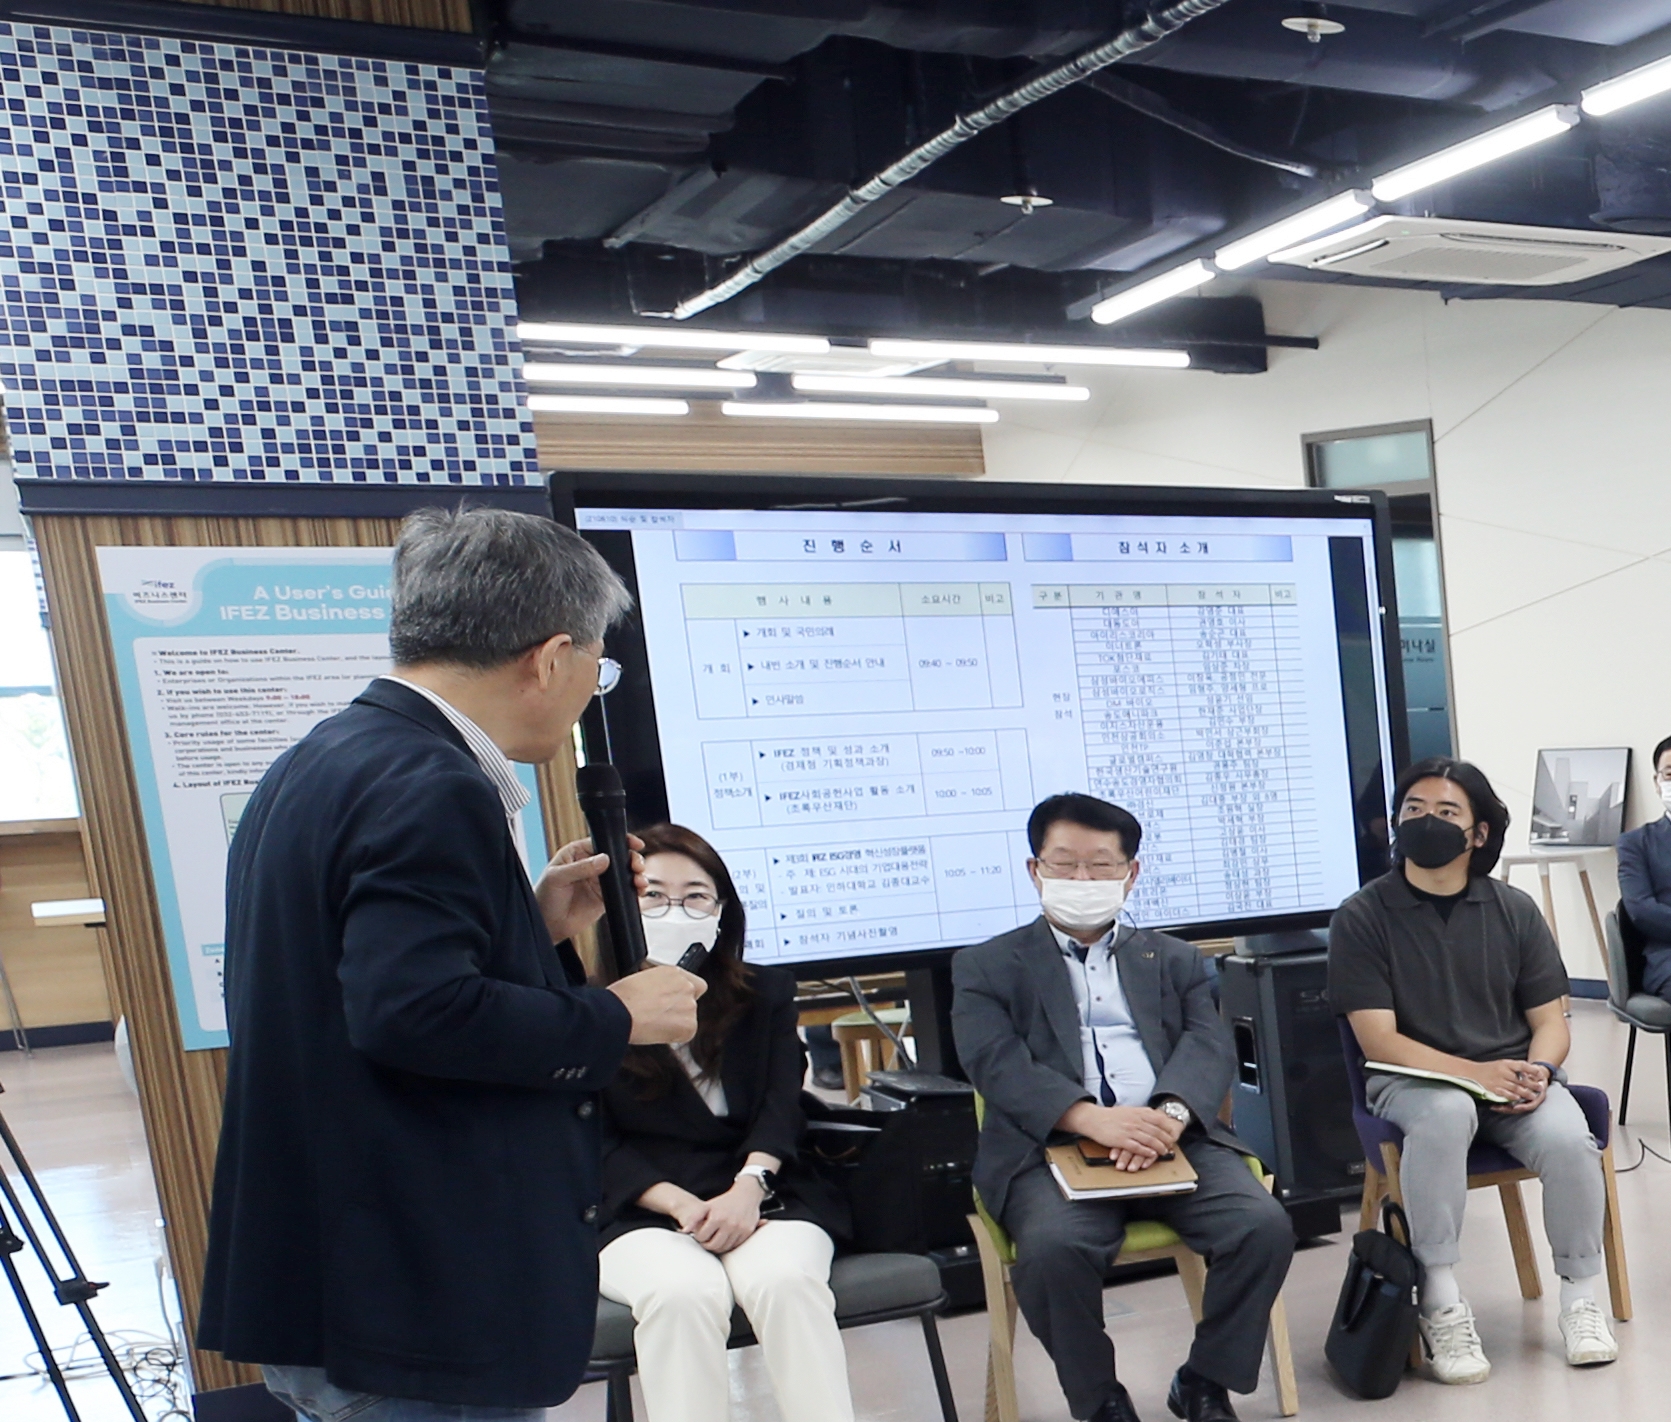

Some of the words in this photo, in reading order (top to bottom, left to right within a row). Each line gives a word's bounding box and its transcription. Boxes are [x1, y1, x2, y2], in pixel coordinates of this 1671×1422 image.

[254, 586, 267, 600] A
[275, 585, 343, 600] User's
[921, 594, 961, 604] 소요시간
[984, 594, 1005, 604] 비고
[220, 605, 271, 620] IFEZ
[275, 604, 385, 620] Business
[1400, 639, 1434, 652] 미나실
[774, 749, 795, 757] IFEZ
